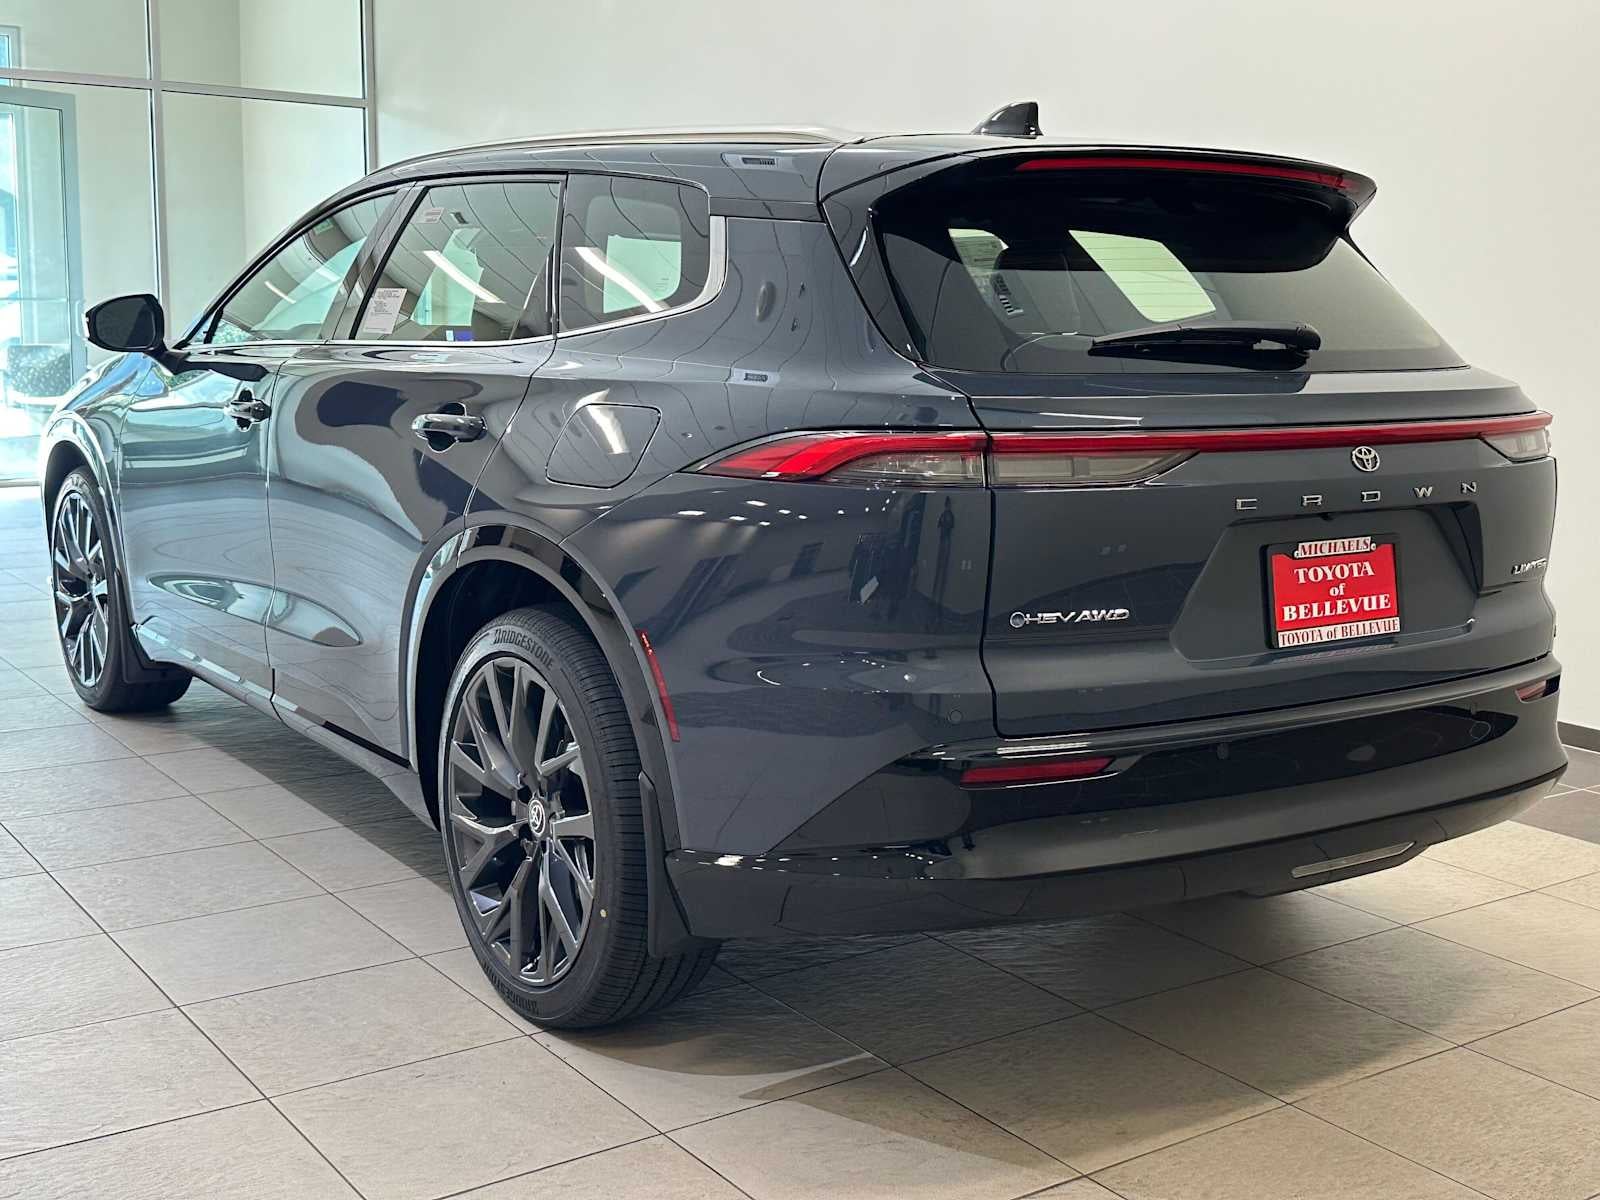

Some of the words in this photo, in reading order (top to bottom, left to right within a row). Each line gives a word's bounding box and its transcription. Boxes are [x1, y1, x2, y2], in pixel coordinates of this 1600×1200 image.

[1236, 481, 1477, 510] CROWN
[1299, 538, 1370, 556] MICHAELS
[1294, 561, 1375, 584] TOYOTA
[1329, 583, 1346, 597] of
[1074, 608, 1130, 623] AWD
[1282, 593, 1391, 622] BELLEVUE
[1279, 628, 1326, 646] TOYOTA
[1326, 628, 1338, 641] of
[1341, 619, 1399, 638] BELLEVUE
[493, 628, 554, 669] BRIDGESTONE
